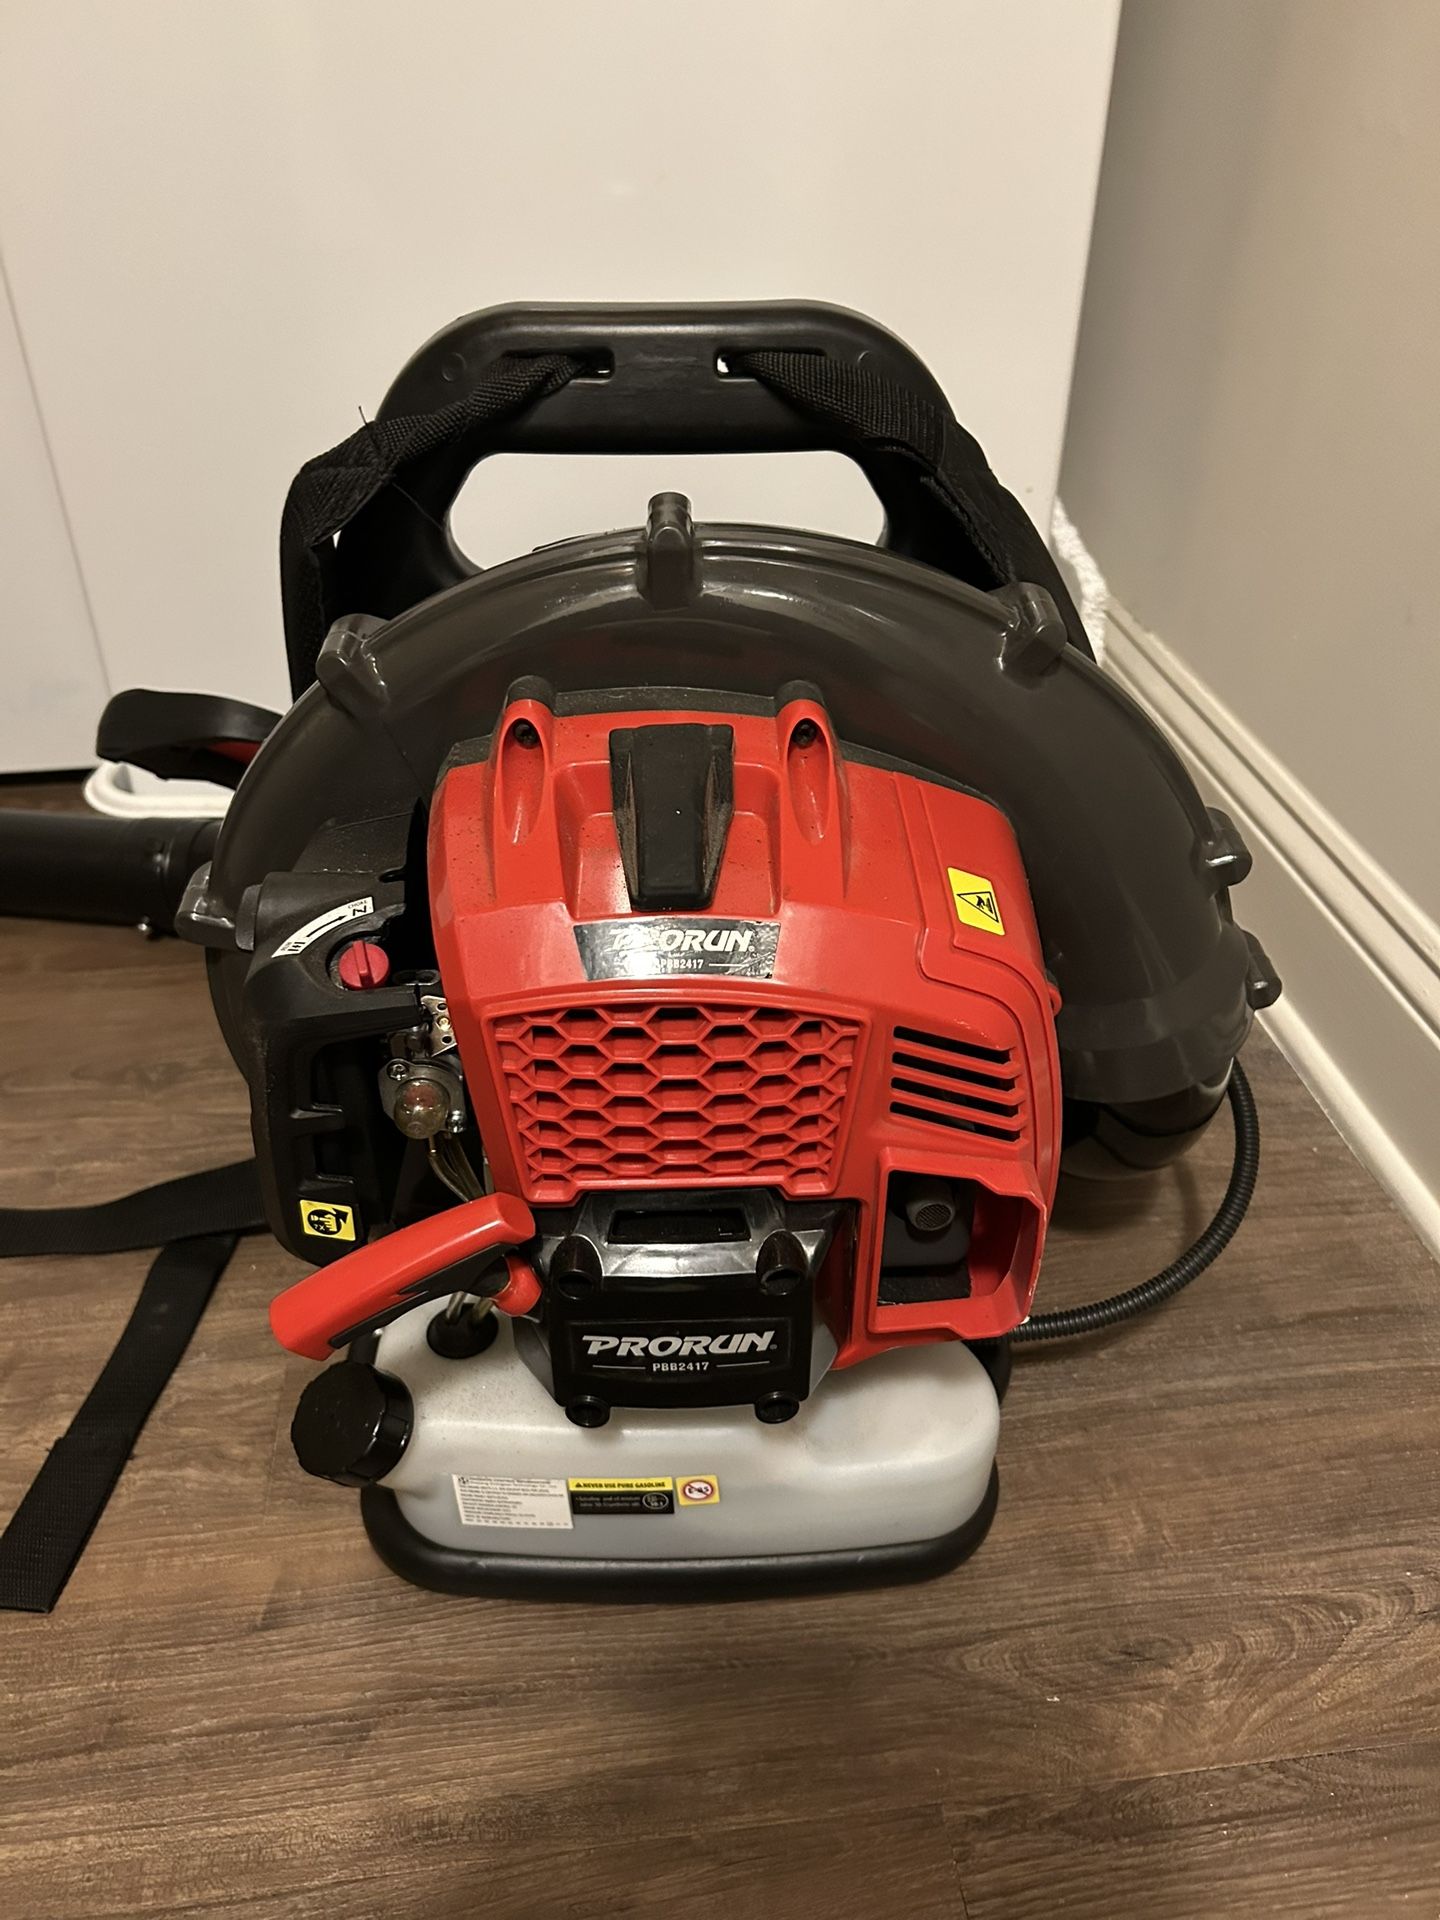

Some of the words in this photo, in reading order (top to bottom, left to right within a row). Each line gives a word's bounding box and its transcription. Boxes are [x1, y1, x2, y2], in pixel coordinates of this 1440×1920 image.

[609, 929, 753, 952] PORUN
[582, 1330, 775, 1357] PRORUN
[652, 1361, 710, 1372] PBB2417
